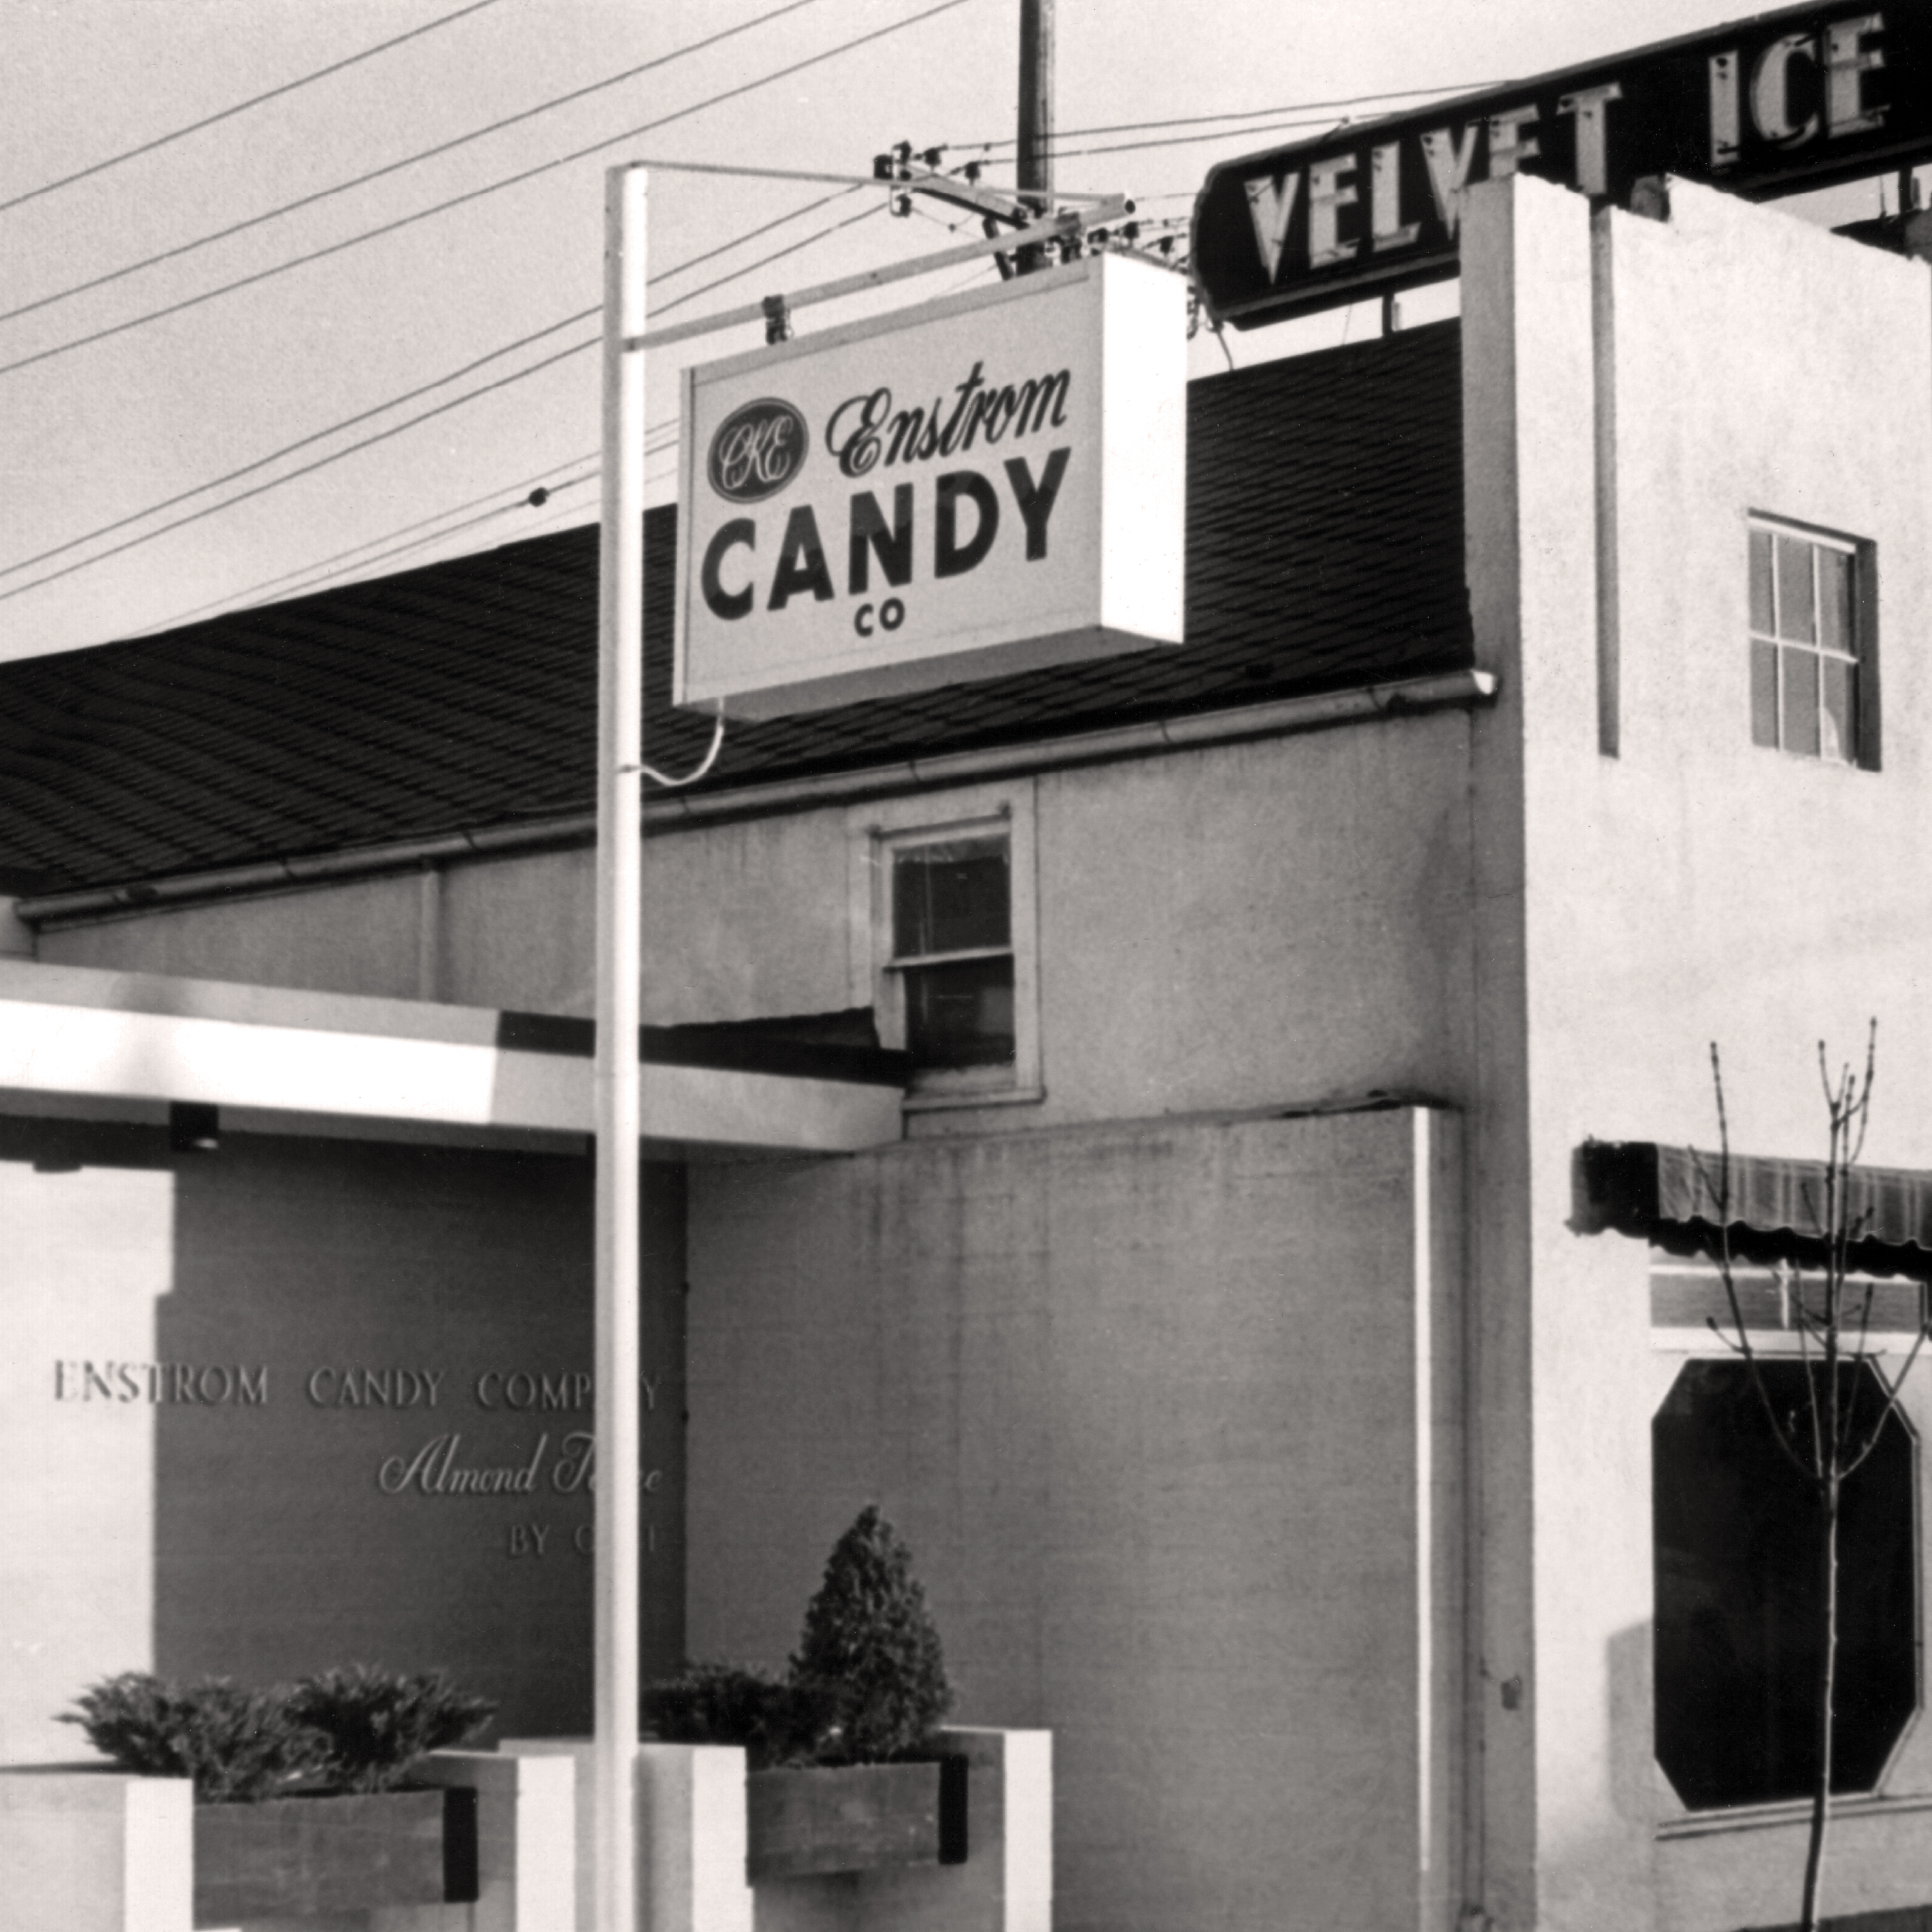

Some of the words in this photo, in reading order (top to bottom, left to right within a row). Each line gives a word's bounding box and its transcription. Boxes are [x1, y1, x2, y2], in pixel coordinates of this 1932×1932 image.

[1707, 13, 1890, 165] ICE
[825, 361, 1071, 478] Enstrom
[701, 447, 1071, 621] CANDY
[854, 598, 905, 637] CO
[54, 1359, 267, 1405] ENSTROM
[309, 1366, 444, 1407] CANDY
[477, 1370, 660, 1410] COMPY
[379, 1433, 547, 1493] Almond
[510, 1525, 549, 1555] BY
